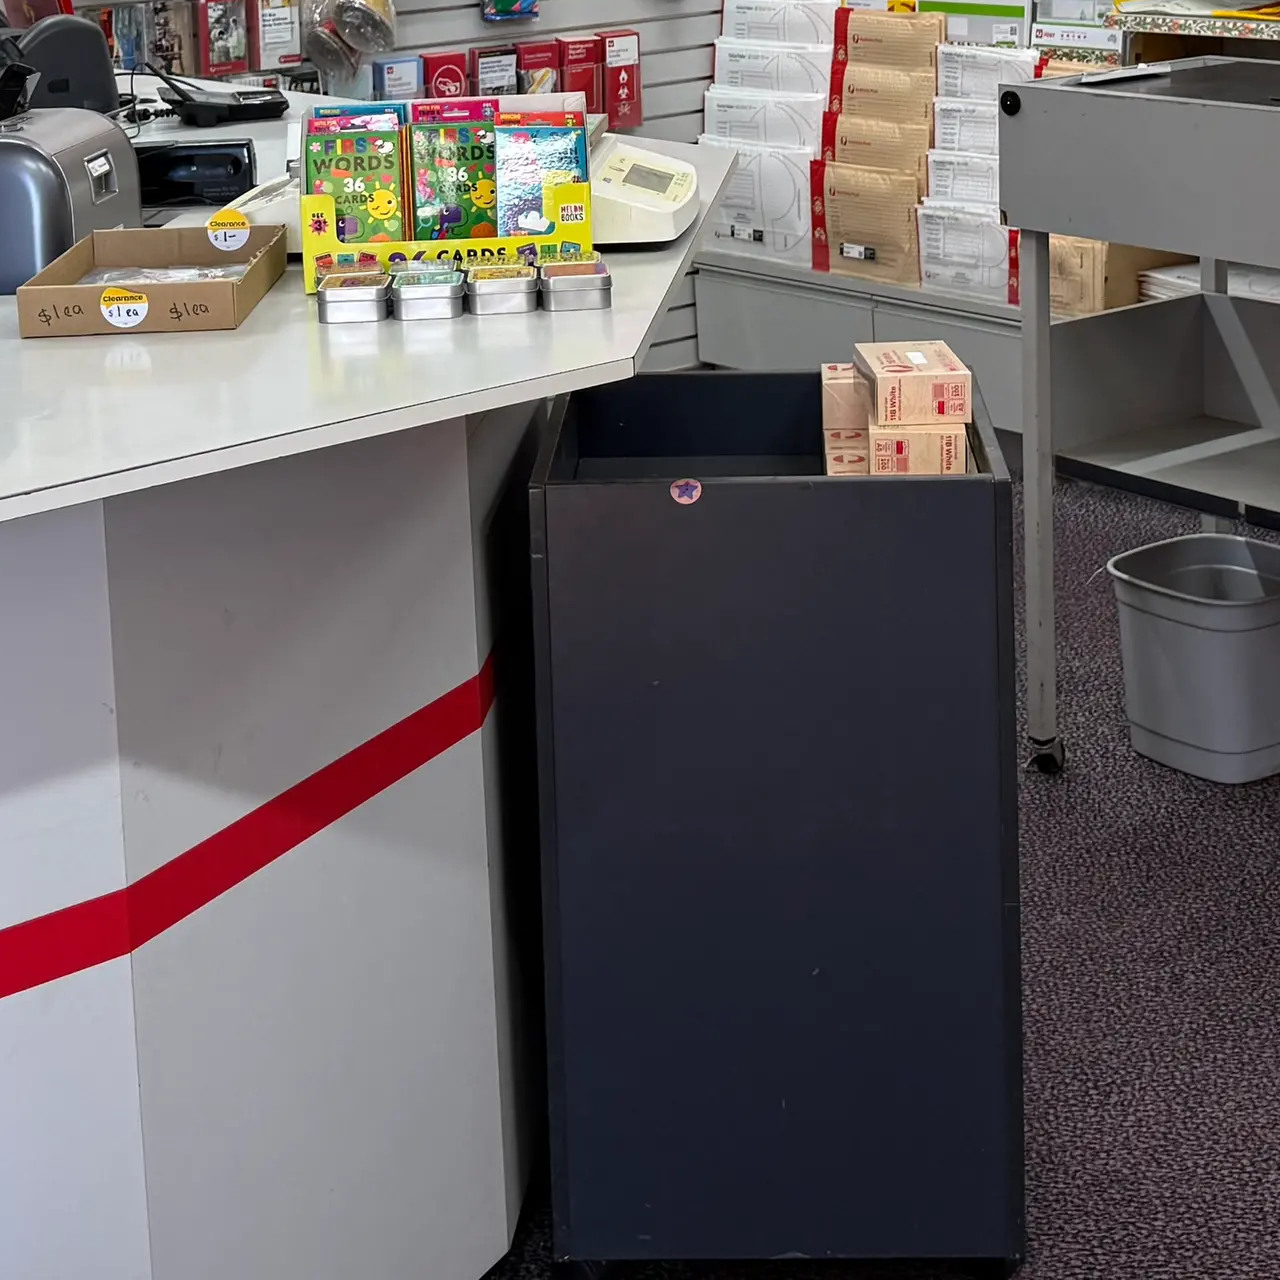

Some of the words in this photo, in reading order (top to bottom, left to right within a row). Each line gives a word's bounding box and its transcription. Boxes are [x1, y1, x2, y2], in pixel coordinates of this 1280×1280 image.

[313, 154, 395, 175] WORDS
[343, 177, 365, 192] 36
[335, 192, 374, 205] CARDS
[561, 205, 584, 213] MELON
[561, 213, 583, 222] BOOKS
[103, 294, 143, 303] Clearance
